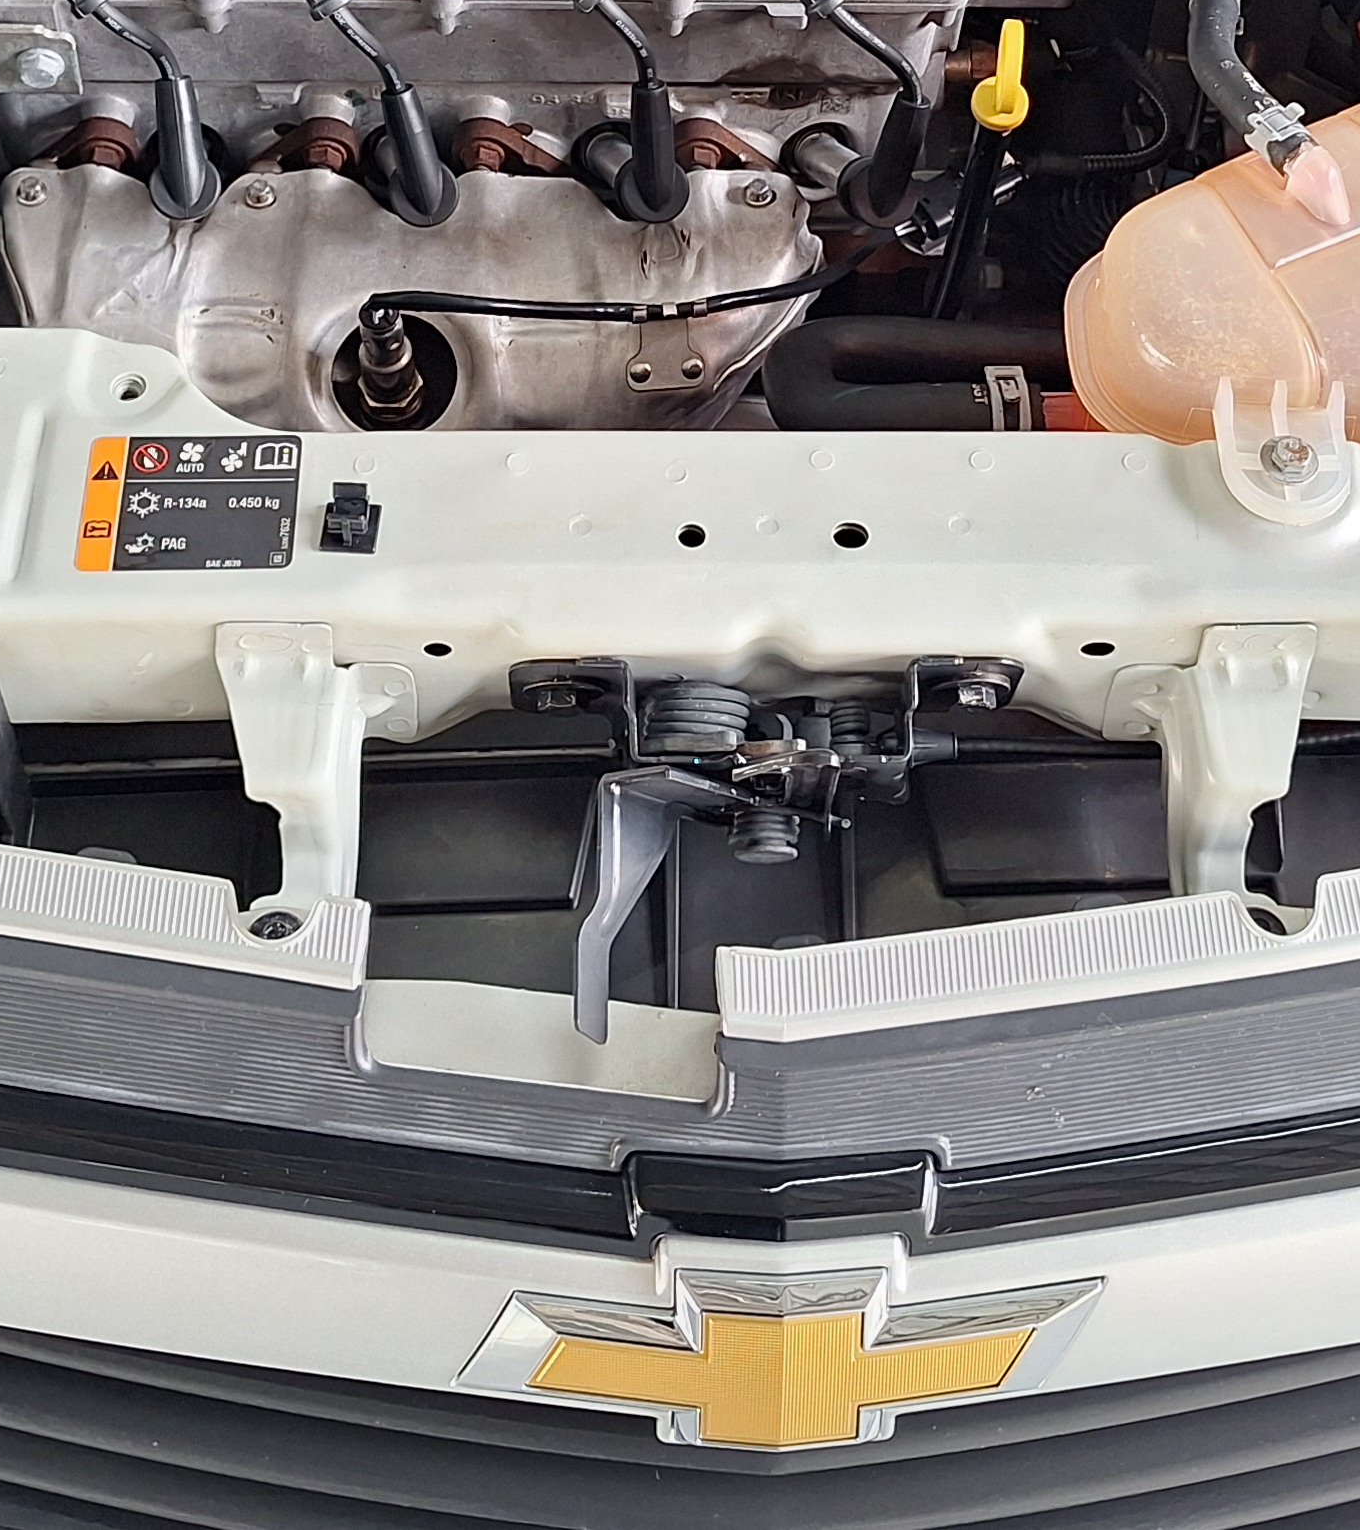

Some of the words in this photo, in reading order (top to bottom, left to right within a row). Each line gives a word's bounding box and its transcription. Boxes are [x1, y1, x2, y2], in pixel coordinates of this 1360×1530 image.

[175, 462, 206, 474] AUTO
[163, 496, 208, 510] R-134a
[228, 496, 262, 510] 0.450
[264, 495, 281, 511] kg
[160, 536, 188, 551] PAG
